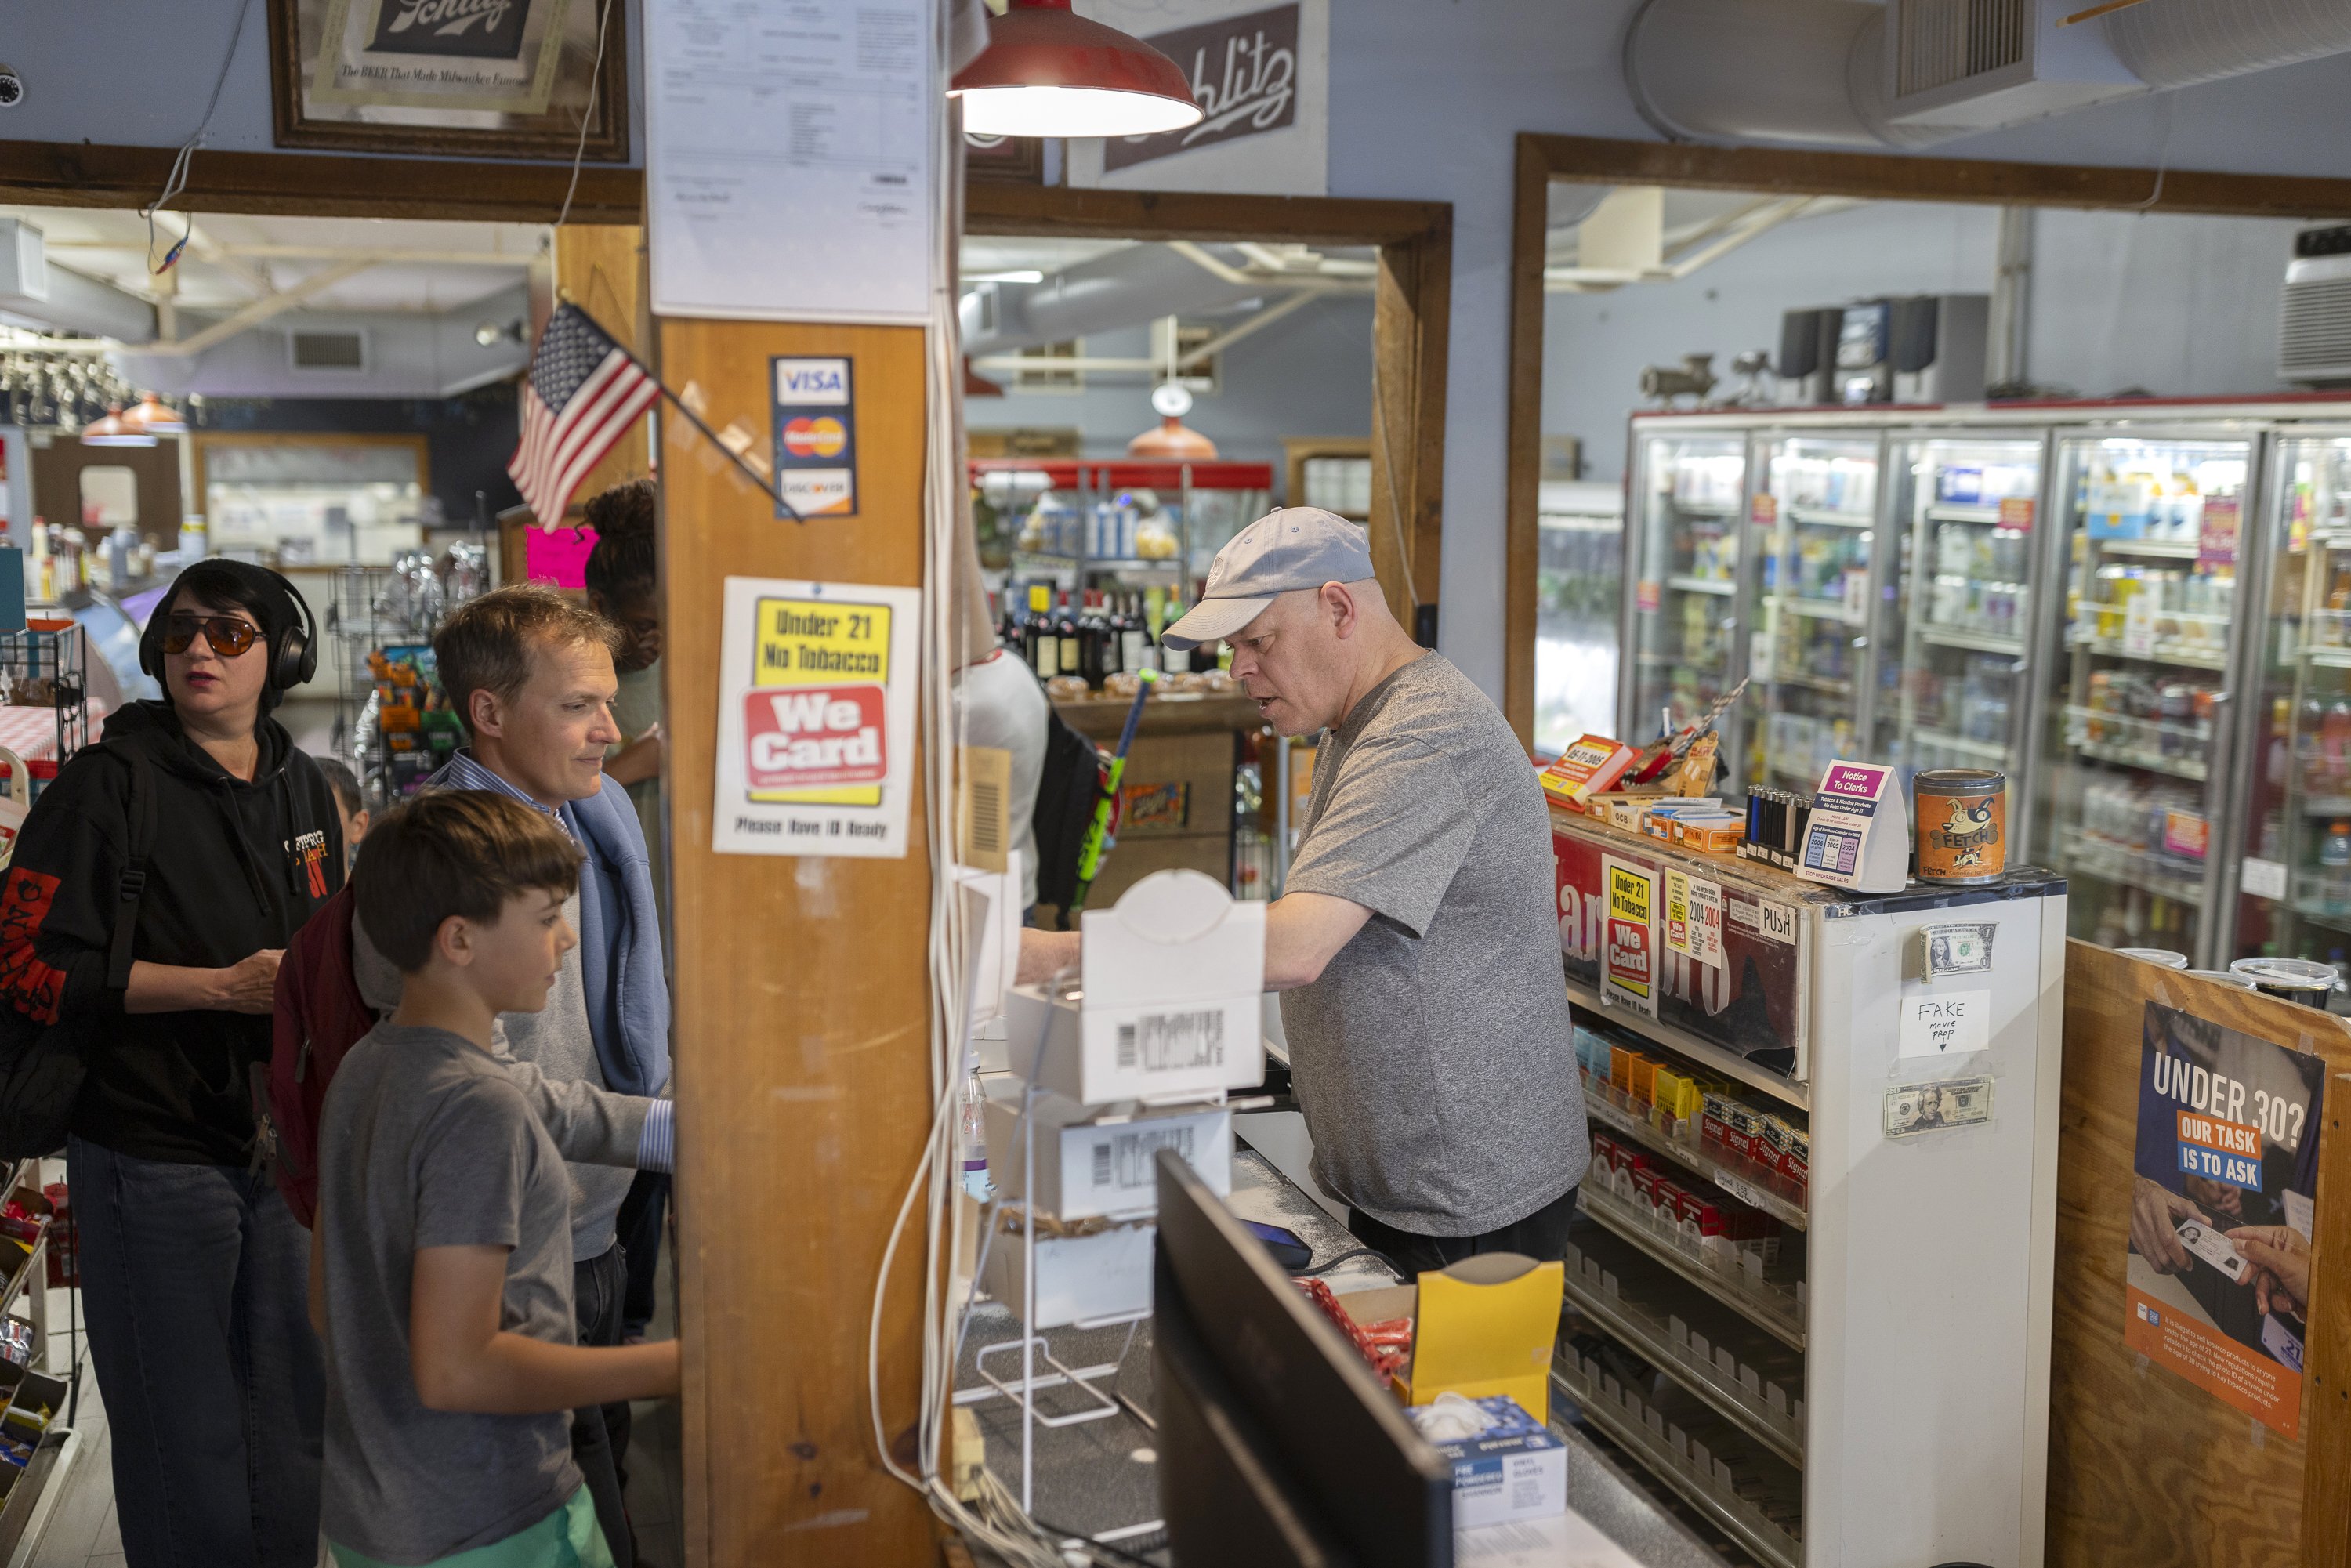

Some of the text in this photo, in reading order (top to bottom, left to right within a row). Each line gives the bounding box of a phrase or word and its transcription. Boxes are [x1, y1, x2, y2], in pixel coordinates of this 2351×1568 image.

[342, 63, 360, 77] The
[360, 65, 387, 78] BEER
[390, 67, 410, 79] That
[413, 68, 437, 82] Made
[440, 70, 491, 84] Milwaukee
[786, 371, 841, 390] VISA
[777, 609, 871, 639] Under 21
[764, 643, 880, 673] No Tobacco
[770, 693, 861, 733] We
[749, 726, 881, 771] Card
[1834, 780, 1868, 793] To Clerks
[1842, 771, 1867, 782] Notice
[735, 817, 781, 835] Please
[788, 819, 820, 837] Have
[846, 820, 888, 838] Ready
[1615, 813, 1628, 824] OCB
[1943, 831, 1988, 847] FETCH
[1816, 873, 1836, 882] UNDERAGE
[1922, 866, 1947, 876] FETCH
[1615, 874, 1644, 900] Under 21
[1612, 892, 1620, 909] No
[1621, 893, 1647, 920] Tobacco
[1690, 900, 1704, 924] 2004
[1705, 906, 1719, 929] 2004
[1672, 922, 1682, 931] We
[1764, 907, 1790, 936] PUSH
[1614, 923, 1641, 950] We
[1671, 929, 1684, 940] Card
[1610, 943, 1648, 972] Card
[1607, 987, 1621, 1004] Please
[1621, 994, 1632, 1008] Have
[1638, 1003, 1652, 1016] Ready
[1918, 1001, 1965, 1021] FAKE
[1929, 1020, 1956, 1030] MOVIE
[1933, 1029, 1954, 1041] PROP
[2154, 1051, 2305, 1149] UNDER 30?
[1704, 1118, 1723, 1136] Signal
[2181, 1116, 2256, 1154] OUR TASK
[1730, 1132, 1749, 1150] Signal
[1759, 1140, 1780, 1164] Signal
[1788, 1157, 1808, 1180] Signal
[2183, 1146, 2258, 1187] IS TO ASK
[2164, 1327, 2179, 1338] under
[2189, 1339, 2198, 1349] age
[2213, 1352, 2225, 1362] New
[2226, 1359, 2255, 1380] regulations
[2255, 1375, 2275, 1391] require
[2175, 1321, 2190, 1334] illegal
[2197, 1334, 2206, 1344] sell
[2207, 1338, 2226, 1354] tobacco
[2226, 1351, 2249, 1368] products
[2257, 1367, 2276, 1382] anyone
[2286, 1339, 2301, 1360] 21
[2164, 1335, 2186, 1350] retailers
[2191, 1349, 2206, 1362] check
[2207, 1358, 2216, 1367] the
[2216, 1363, 2231, 1376] photo
[2231, 1371, 2237, 1379] ID
[2244, 1378, 2263, 1394] anyone
[2263, 1389, 2280, 1403] under
[2164, 1343, 2172, 1353] the
[2172, 1349, 2182, 1358] age
[2188, 1356, 2195, 1365] 30
[2196, 1360, 2210, 1375] trying
[2216, 1373, 2226, 1384] buy
[2227, 1379, 2248, 1395] tobacco
